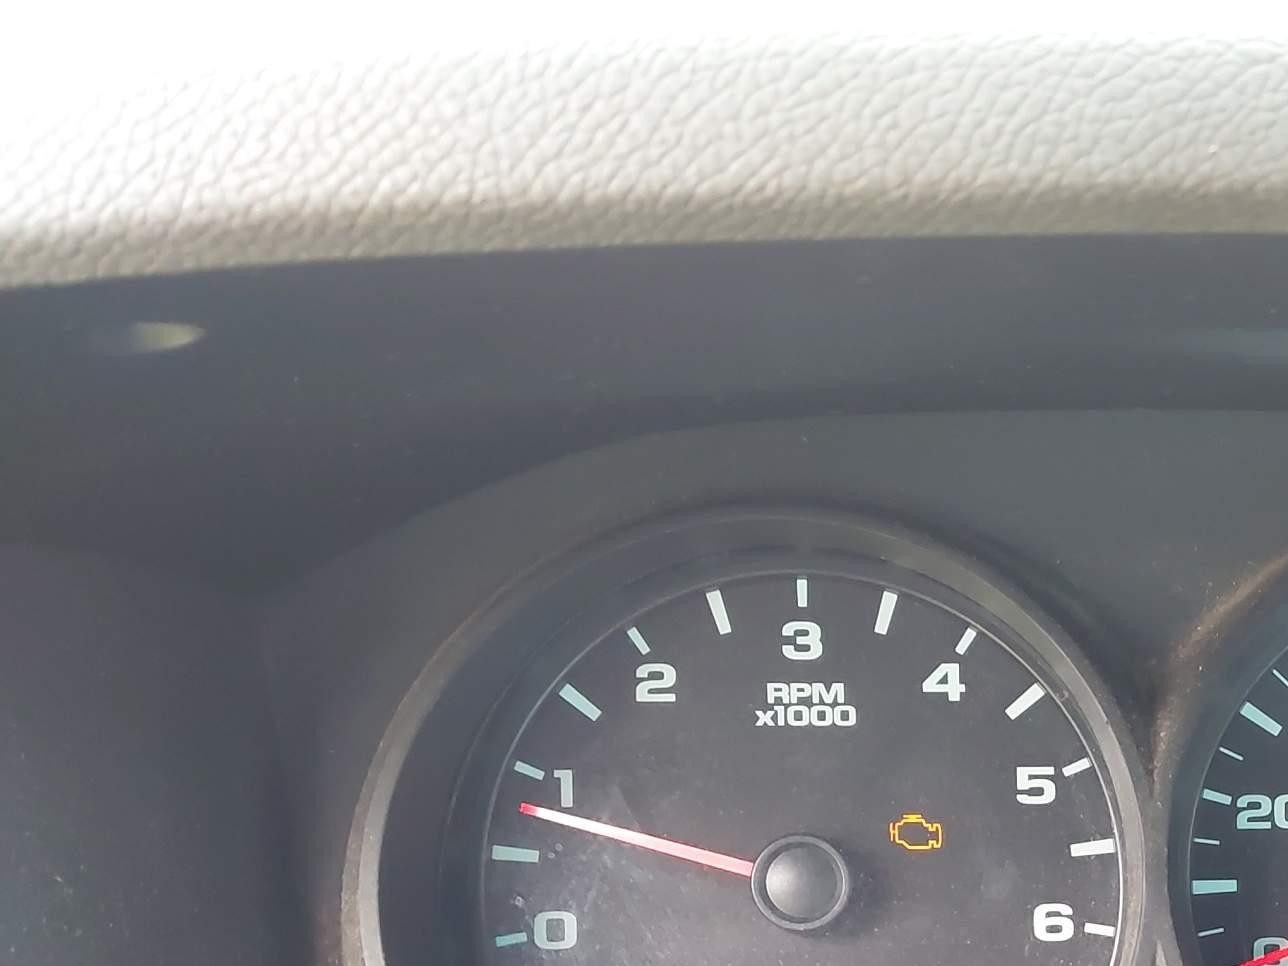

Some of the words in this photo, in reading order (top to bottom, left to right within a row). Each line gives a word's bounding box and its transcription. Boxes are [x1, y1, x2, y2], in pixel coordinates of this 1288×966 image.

[782, 622, 823, 660] 3
[636, 663, 676, 702] 2
[766, 683, 845, 704] RPM
[922, 663, 966, 702] 4
[755, 705, 857, 727] x1000
[554, 769, 574, 808] 1
[1016, 766, 1057, 805] 5
[533, 910, 578, 951] 0
[1032, 902, 1075, 942] 6
